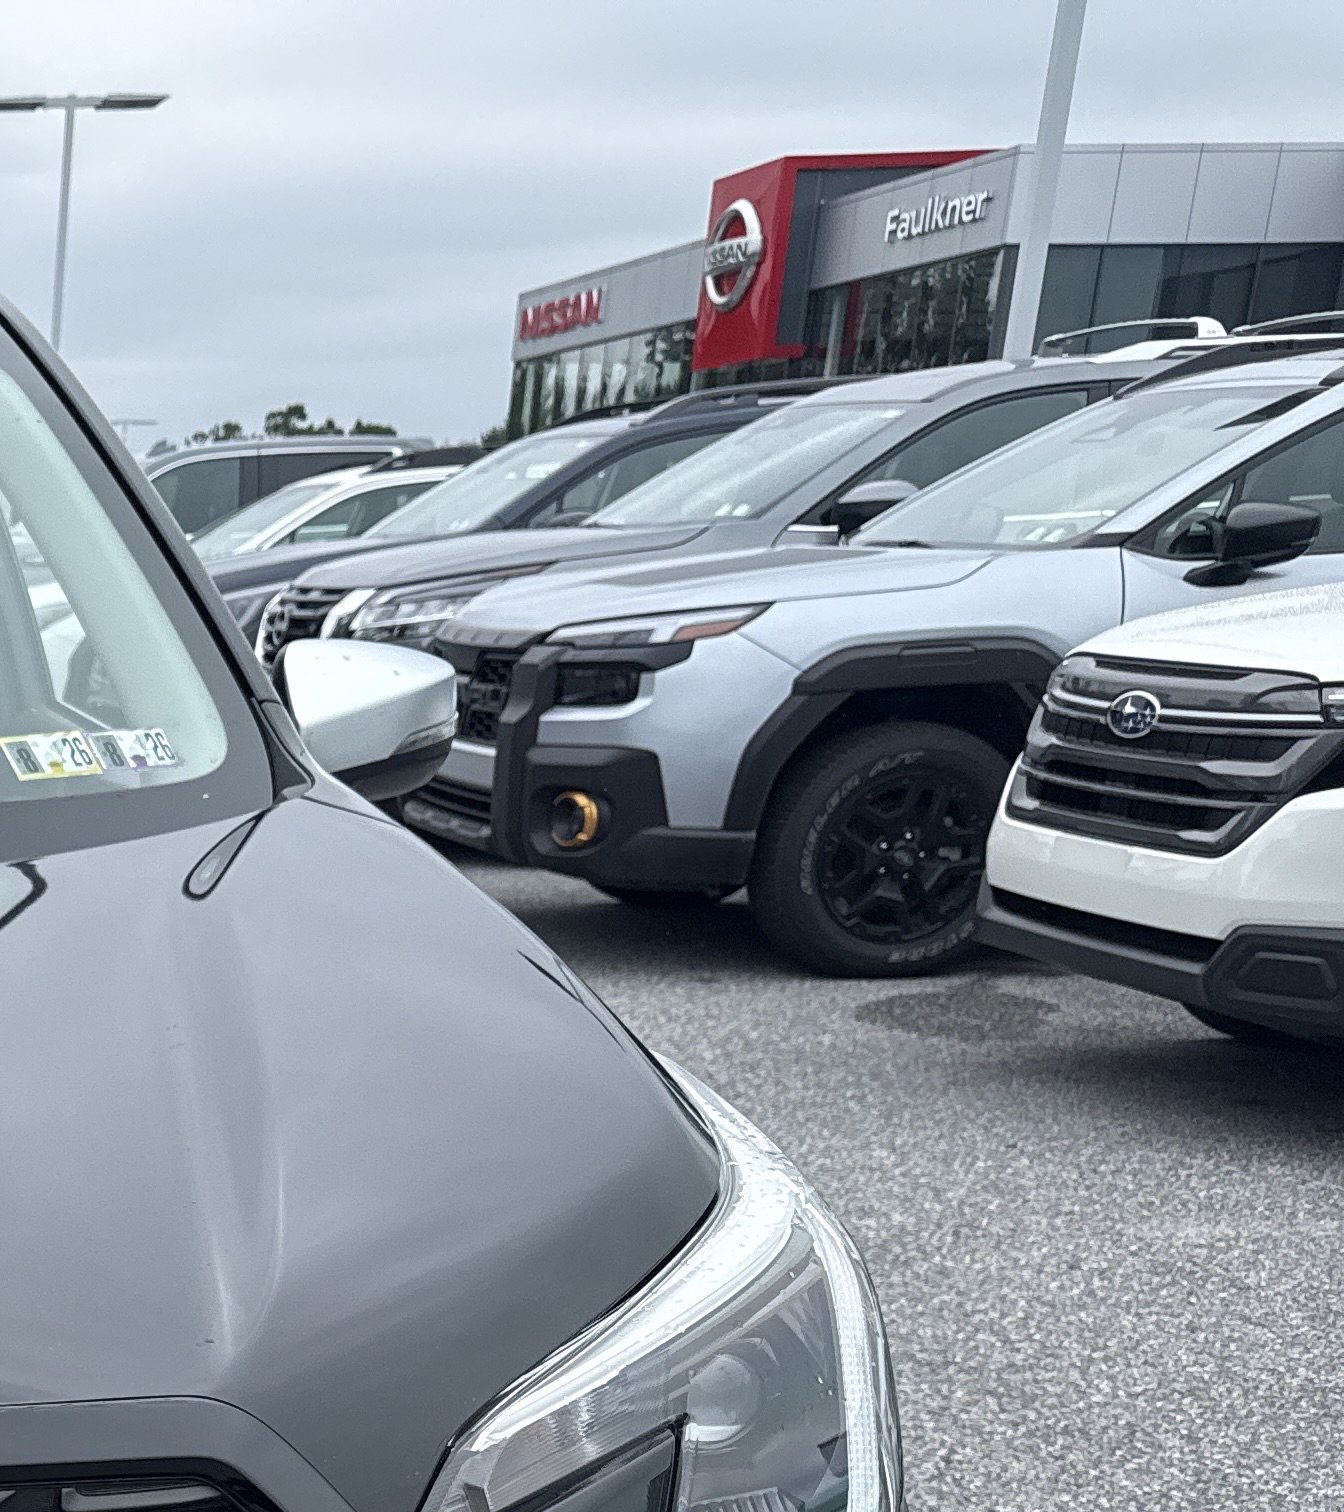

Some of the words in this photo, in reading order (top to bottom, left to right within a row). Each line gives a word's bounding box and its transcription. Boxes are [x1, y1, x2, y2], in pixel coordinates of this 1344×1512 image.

[884, 189, 988, 243] Faulkner
[519, 286, 603, 340] NISSAN
[16, 747, 39, 773] 8
[61, 736, 93, 767] 26
[103, 741, 125, 767] 8
[144, 731, 176, 761] 26
